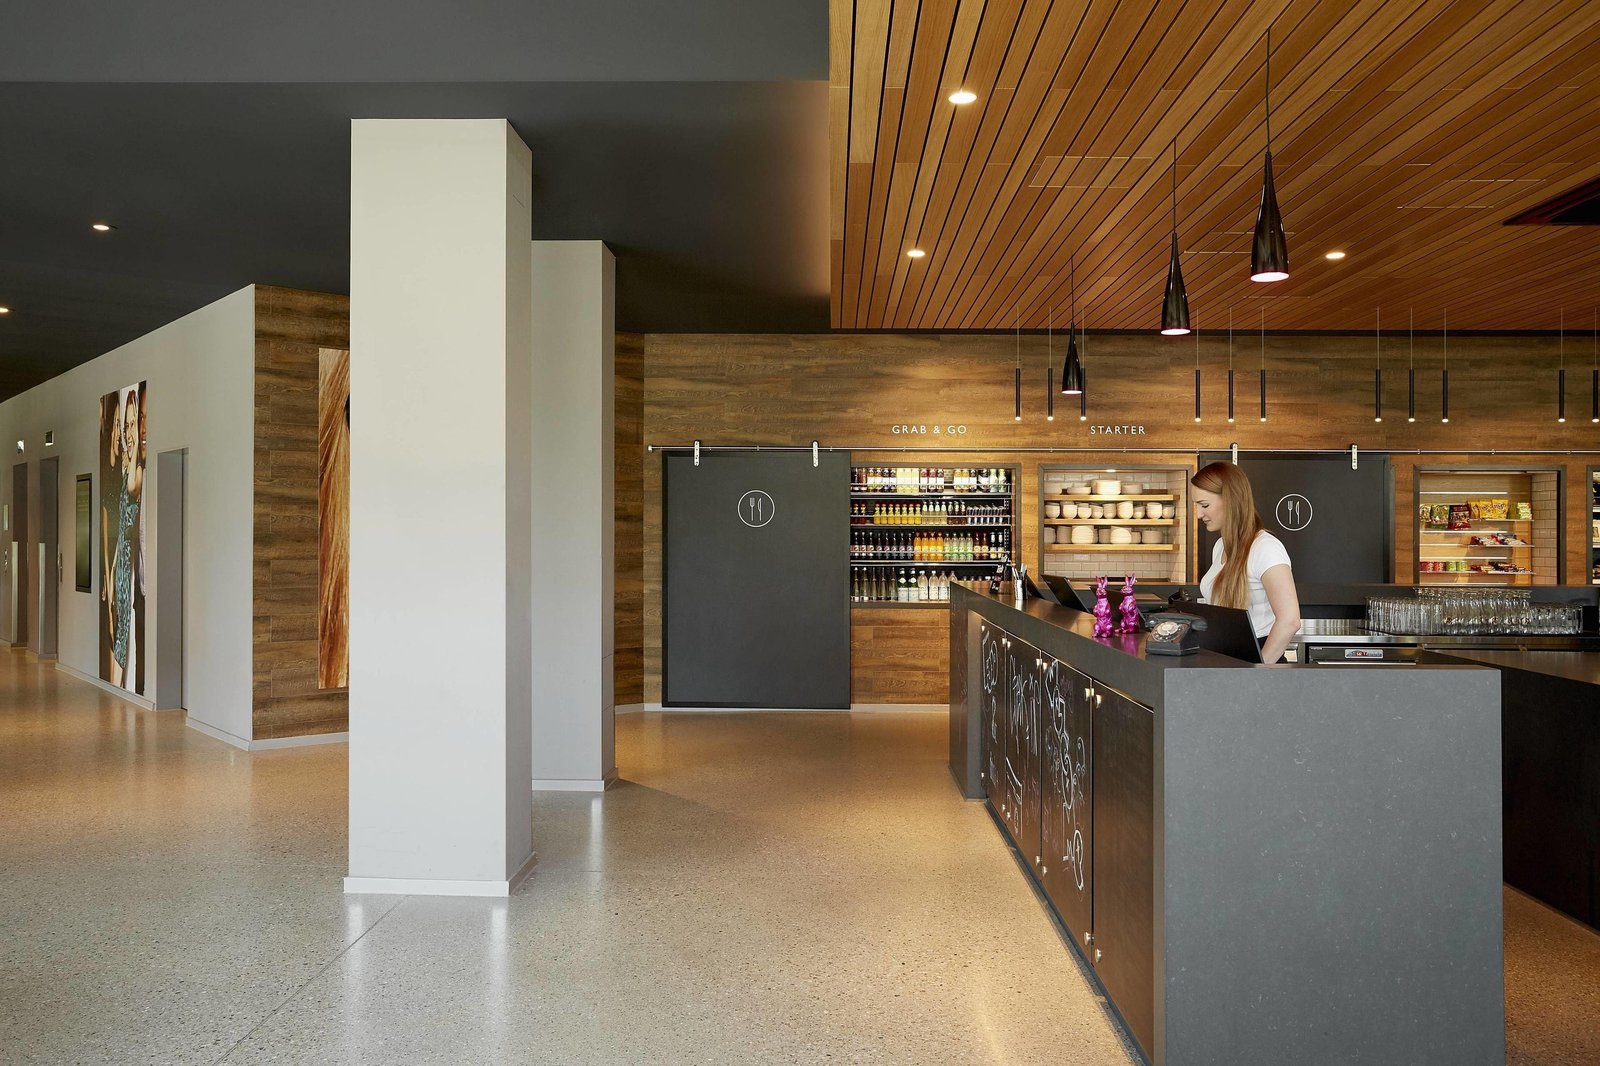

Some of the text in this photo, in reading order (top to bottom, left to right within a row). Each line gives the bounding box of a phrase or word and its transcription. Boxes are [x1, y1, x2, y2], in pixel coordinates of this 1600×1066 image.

[892, 425, 967, 434] GRAB & GO
[1090, 425, 1146, 435] STARTER
